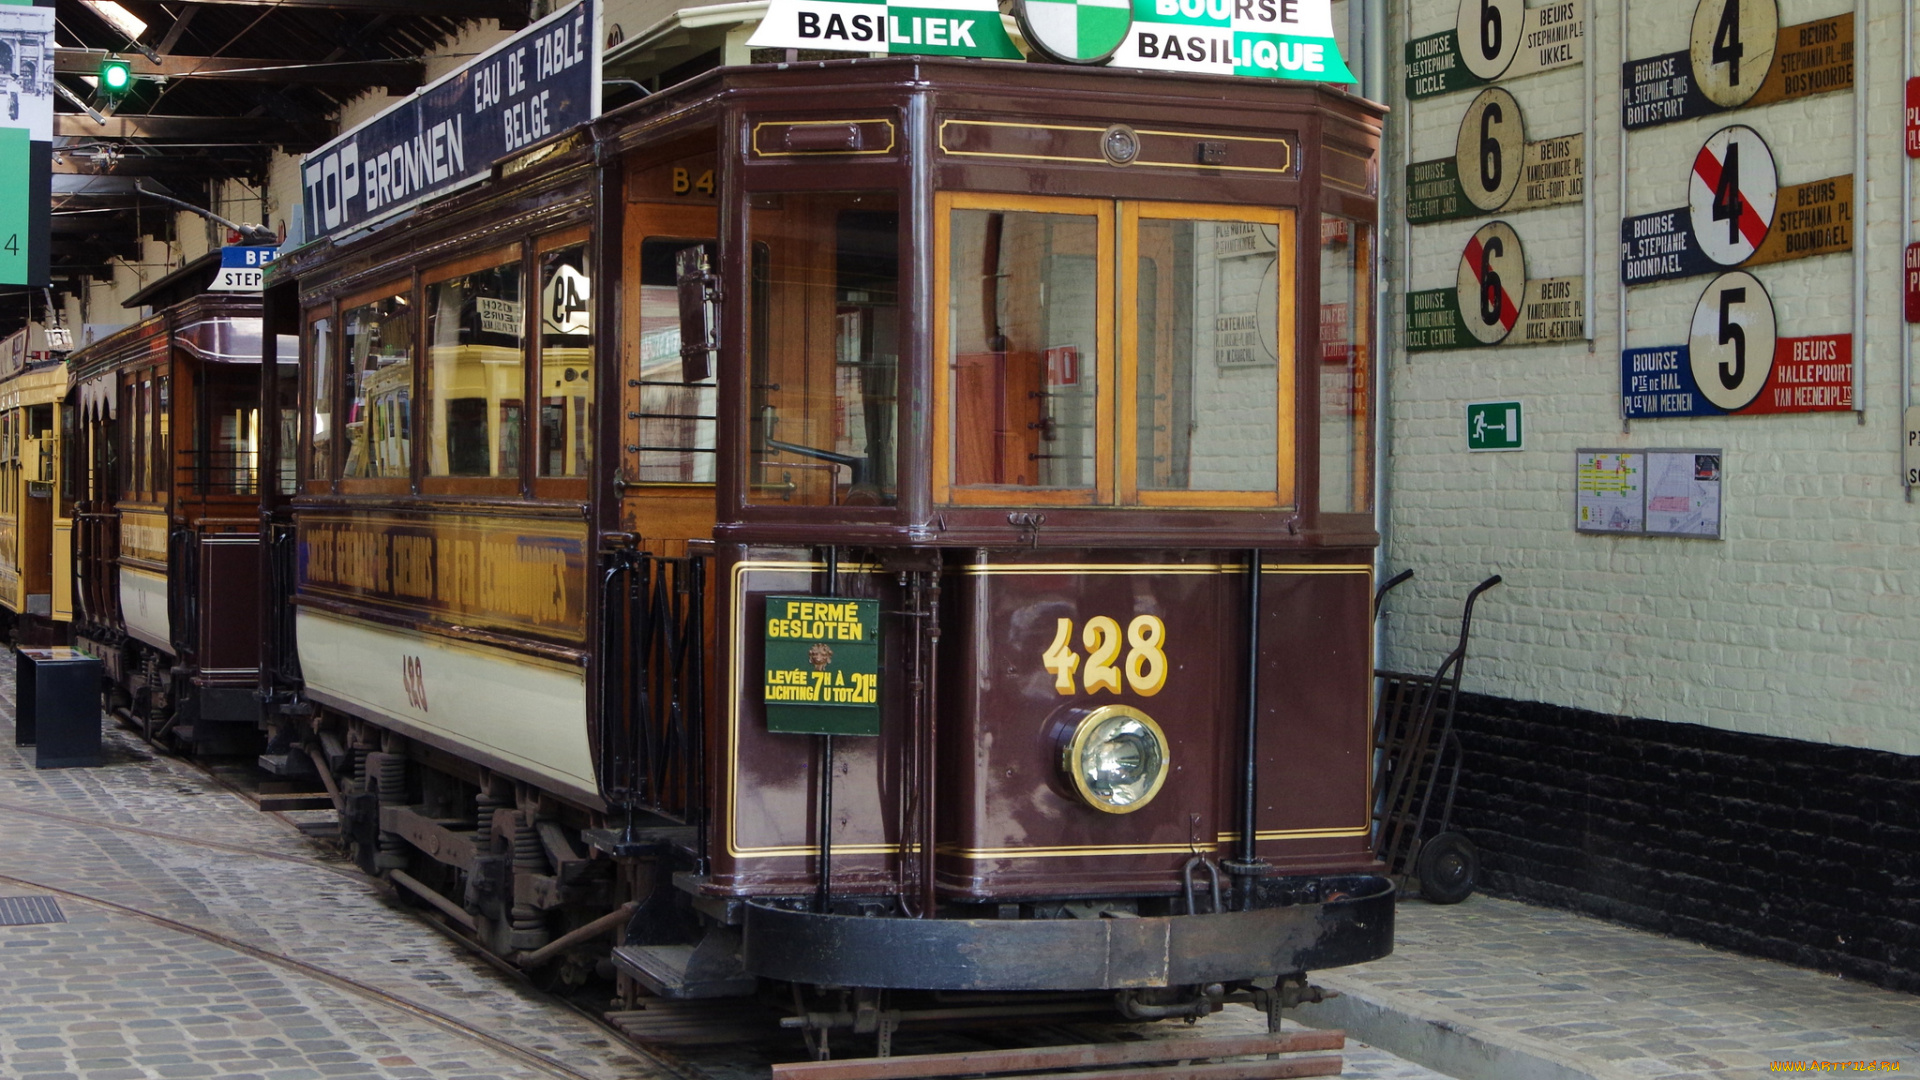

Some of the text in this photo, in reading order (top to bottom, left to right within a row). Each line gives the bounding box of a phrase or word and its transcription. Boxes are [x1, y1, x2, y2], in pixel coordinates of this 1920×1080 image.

[1156, 0, 1298, 23] BOURSE
[1540, 3, 1574, 26] BEURS
[798, 11, 976, 47] BASILIEK
[1481, 0, 1502, 60] 6
[1528, 24, 1568, 48] STEPHANIA
[1800, 22, 1838, 48] BEURS
[1138, 32, 1325, 72] BASILIQUE
[1416, 35, 1450, 59] BOURSE
[1540, 44, 1573, 66] UKKEL
[1712, 0, 1743, 86] 4
[475, 15, 584, 114] EAU DE TABLE
[1420, 53, 1456, 76] STEPHANIE
[1636, 58, 1675, 84] BOURSE
[1781, 47, 1822, 74] STEPHANIA
[1416, 74, 1446, 95] UCCLE
[504, 90, 550, 152] BELGE
[1628, 98, 1684, 125] BOITSFORT
[1480, 103, 1502, 192] 6
[1541, 141, 1570, 160] BEURS
[306, 113, 465, 236] TOP BRONNEN
[1415, 162, 1445, 182] BOURSE
[1713, 142, 1742, 244] 4
[1798, 182, 1836, 207] BEURS
[1634, 214, 1674, 239] BOURSE
[1780, 207, 1832, 232] STEPHANIA
[1638, 232, 1687, 258] STEPHANIE
[1786, 226, 1848, 253] BOONDAEL
[1627, 254, 1682, 280] BOONDAEL
[1480, 236, 1503, 325] 6
[1542, 282, 1570, 300] BEURS
[1414, 292, 1445, 310] BOURSE
[1430, 328, 1456, 345] CENTRE
[1527, 322, 1547, 340] UKKEL
[1719, 287, 1746, 390] 5
[1633, 351, 1678, 372] BOURSE
[1794, 340, 1837, 361] BEURS
[1650, 378, 1659, 391] DE
[1660, 373, 1681, 390] HAL
[1642, 394, 1658, 413] VAN
[1660, 392, 1692, 412] MEENEN
[1774, 388, 1792, 407] VAN
[787, 602, 858, 622] FERMÉ
[768, 618, 862, 640] GESLOTEN
[1042, 615, 1168, 697] 428
[768, 669, 807, 684] LEVÉE
[836, 670, 844, 686] À
[766, 686, 814, 700] LICHTING
[833, 688, 853, 702] TOT
